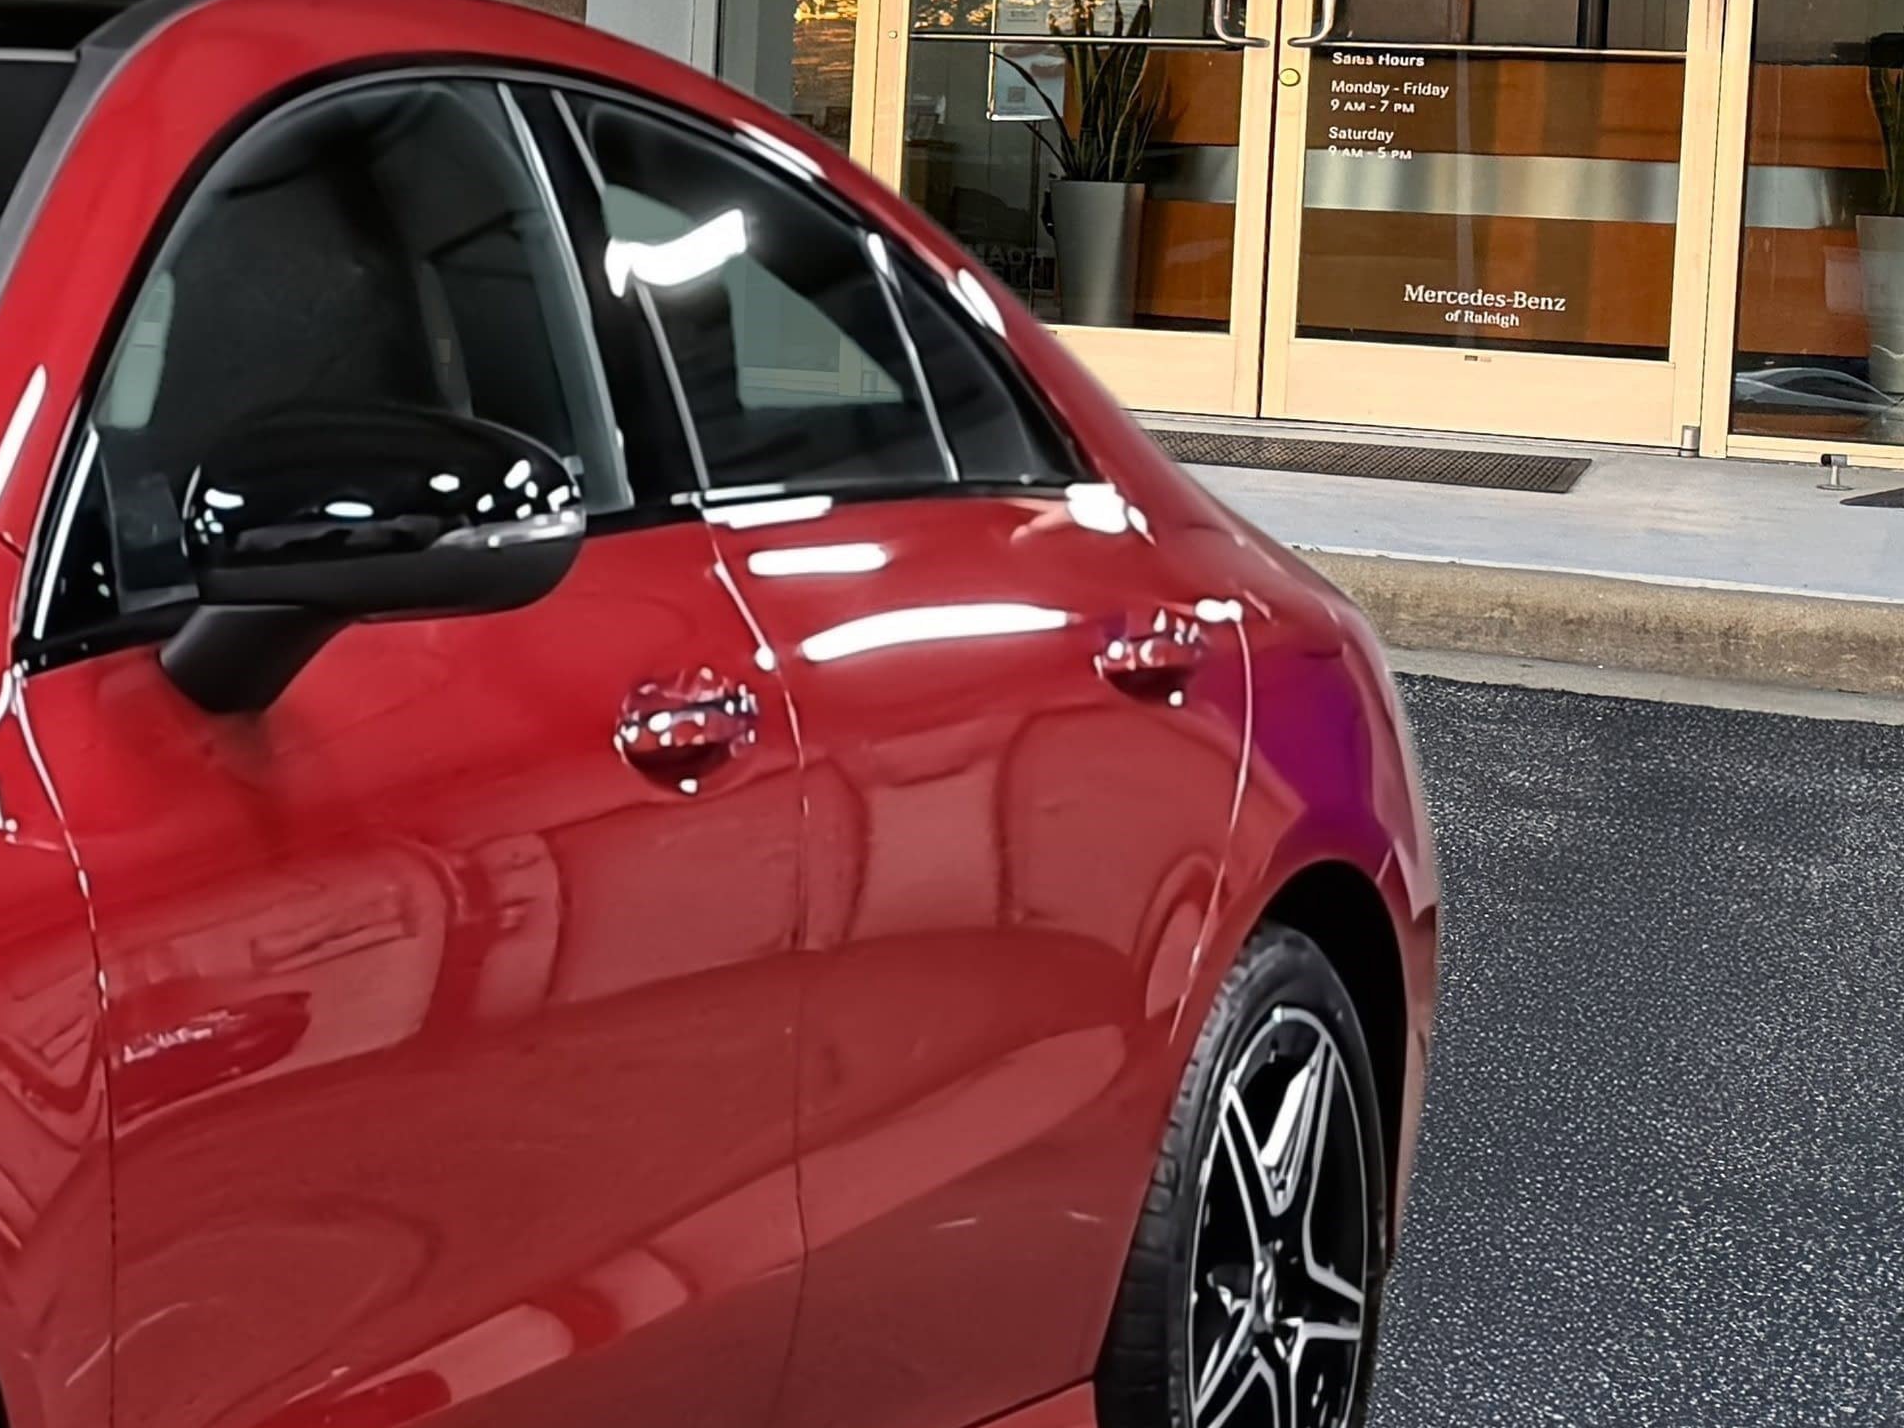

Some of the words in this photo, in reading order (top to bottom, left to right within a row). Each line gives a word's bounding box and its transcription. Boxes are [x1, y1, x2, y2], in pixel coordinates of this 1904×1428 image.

[1378, 52, 1425, 67] Hours
[1331, 80, 1390, 97] Monday
[1403, 82, 1449, 98] Friday
[1330, 98, 1340, 111] 9
[1344, 101, 1366, 111] AM
[1379, 100, 1389, 112] 7
[1393, 103, 1415, 113] PM
[1328, 126, 1394, 144] Saturday
[1328, 145, 1337, 157] 9
[1342, 148, 1364, 158] AM
[1378, 146, 1386, 159] 5
[1391, 149, 1413, 160] PM
[1403, 284, 1566, 312] Mercedes-Benz
[1445, 309, 1462, 323] of
[1464, 310, 1520, 329] Raleigh
